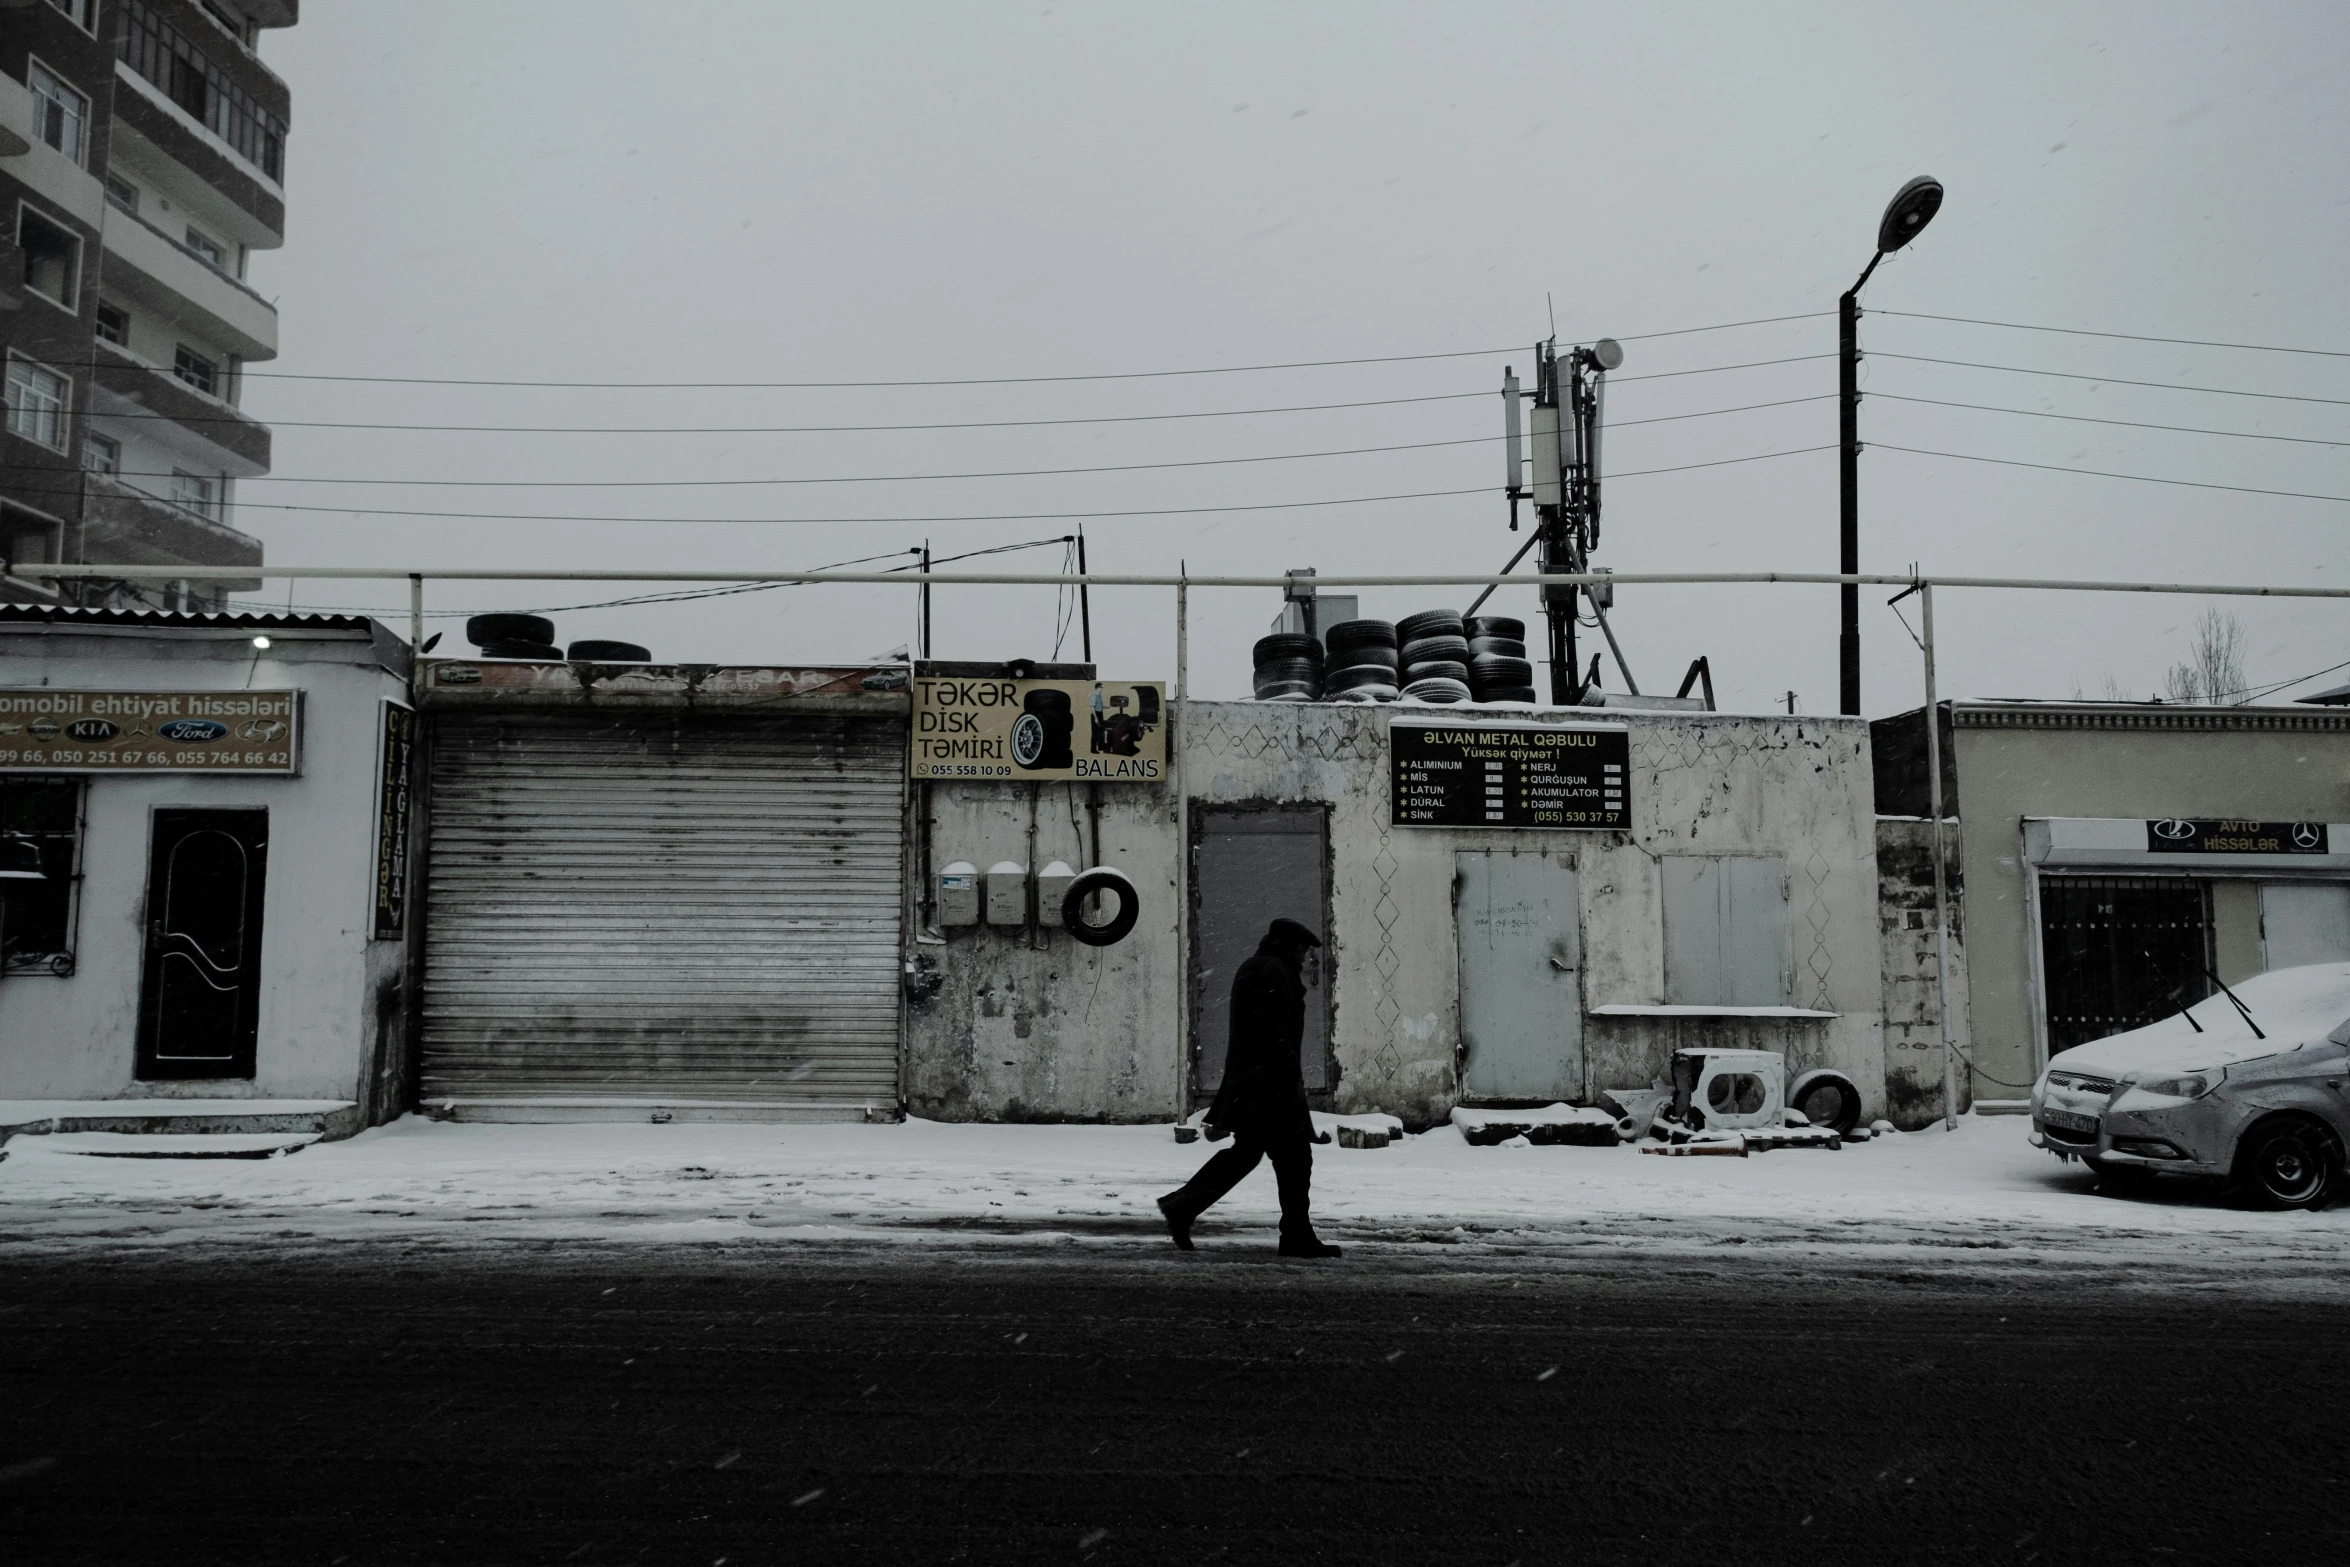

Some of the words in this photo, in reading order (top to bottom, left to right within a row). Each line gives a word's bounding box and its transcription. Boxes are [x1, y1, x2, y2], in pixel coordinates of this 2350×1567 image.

[917, 681, 1019, 707] TƏKƏR
[91, 694, 180, 719] ehtiyat
[188, 696, 291, 716] hissələri
[920, 706, 979, 733] DİSK
[74, 722, 111, 737] KIA
[171, 721, 217, 741] Ford
[1423, 731, 1476, 745] ƏLVAN
[1478, 733, 1530, 746] METAL
[1533, 733, 1597, 748] QƏBULU
[918, 735, 1004, 760] TƏMİRİ
[23, 751, 47, 765] 66,
[52, 751, 84, 764] 050
[87, 751, 117, 764] 251
[122, 752, 142, 764] 67
[147, 752, 171, 767] 66,
[176, 752, 206, 764] 055
[211, 752, 241, 764] 764
[244, 752, 264, 765] 66
[268, 753, 288, 765] 42
[931, 765, 953, 776] 055
[956, 765, 977, 777] 558
[980, 765, 993, 777] 10
[996, 765, 1012, 777] 09
[1075, 758, 1159, 778] BALANS
[1530, 762, 1557, 773] NERJ
[1410, 771, 1429, 782] MİS
[1410, 785, 1445, 795] LATUN
[1530, 788, 1600, 798] AKUMULATOR
[1531, 798, 1565, 810] DƏMİR
[1410, 808, 1434, 820] SİNK
[1534, 811, 1563, 824] (055)
[1566, 811, 1586, 823] 530
[1589, 812, 1603, 823] 37
[1605, 812, 1619, 824] 57
[2219, 821, 2260, 833] AVTO
[2204, 833, 2280, 851] HİSSƏLƏR
